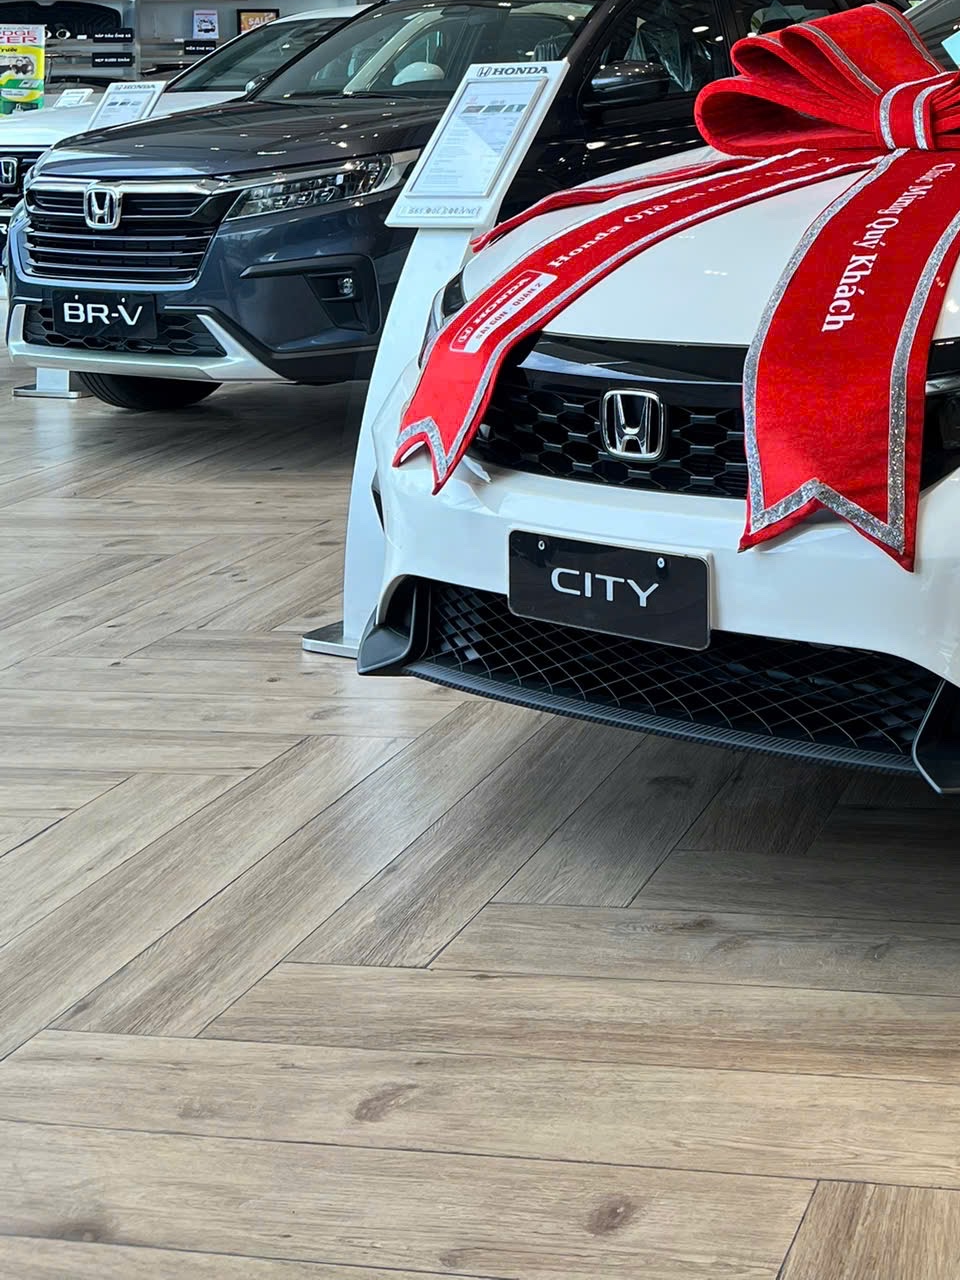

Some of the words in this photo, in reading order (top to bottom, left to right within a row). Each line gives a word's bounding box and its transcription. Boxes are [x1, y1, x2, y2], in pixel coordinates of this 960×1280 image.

[493, 66, 549, 76] HONDA
[547, 225, 623, 268] Honda
[853, 217, 899, 250] Quý
[473, 277, 532, 325] HONDA
[821, 253, 878, 332] Khách
[63, 302, 143, 326] BR-V
[551, 567, 659, 608] CITY
